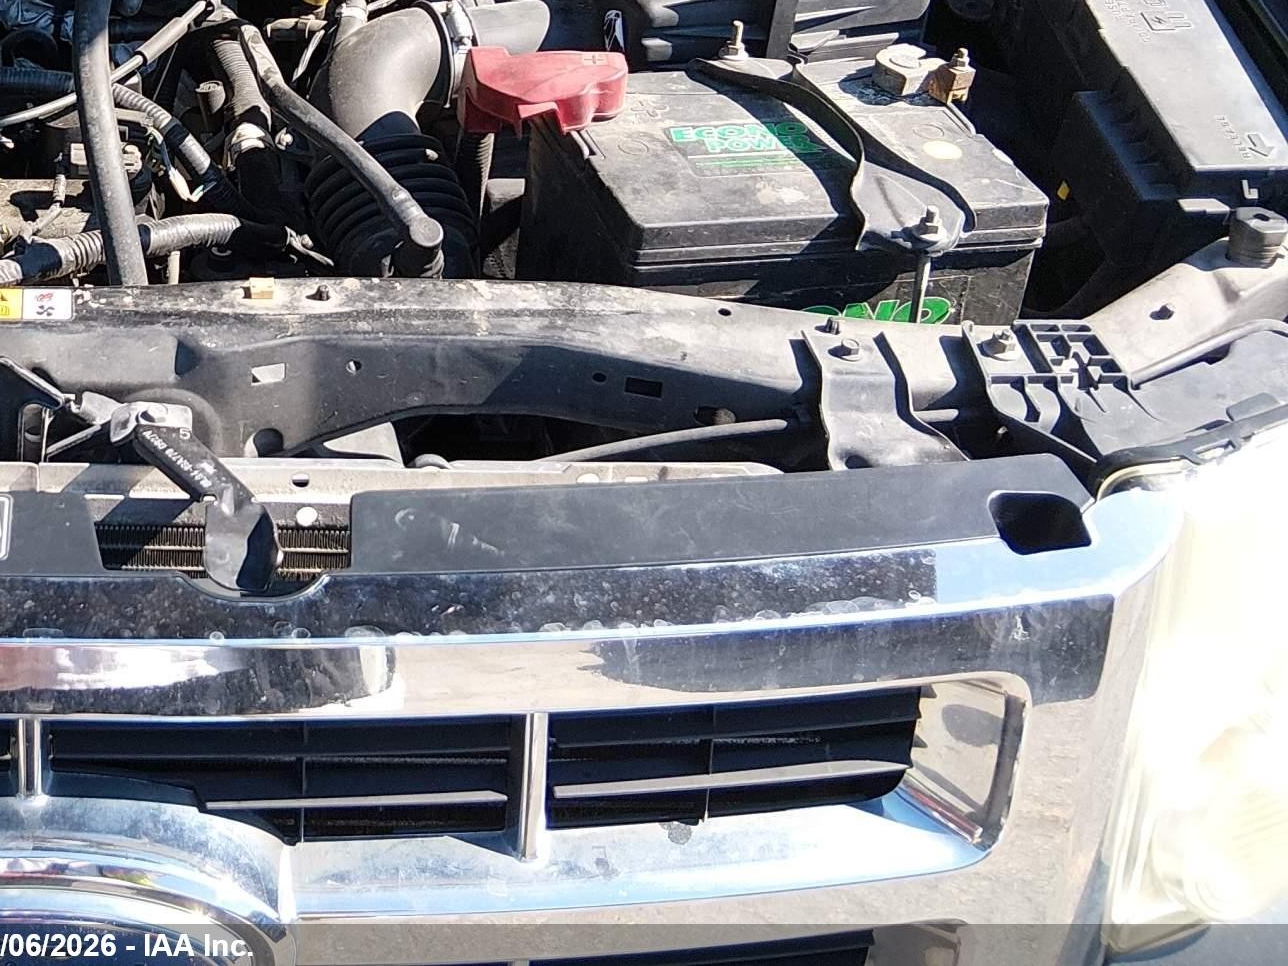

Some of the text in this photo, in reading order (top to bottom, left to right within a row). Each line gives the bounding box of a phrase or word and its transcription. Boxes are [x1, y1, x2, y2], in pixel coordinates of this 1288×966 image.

[669, 122, 809, 143] ECONO
[703, 134, 829, 154] POWER
[179, 427, 191, 440] 5
